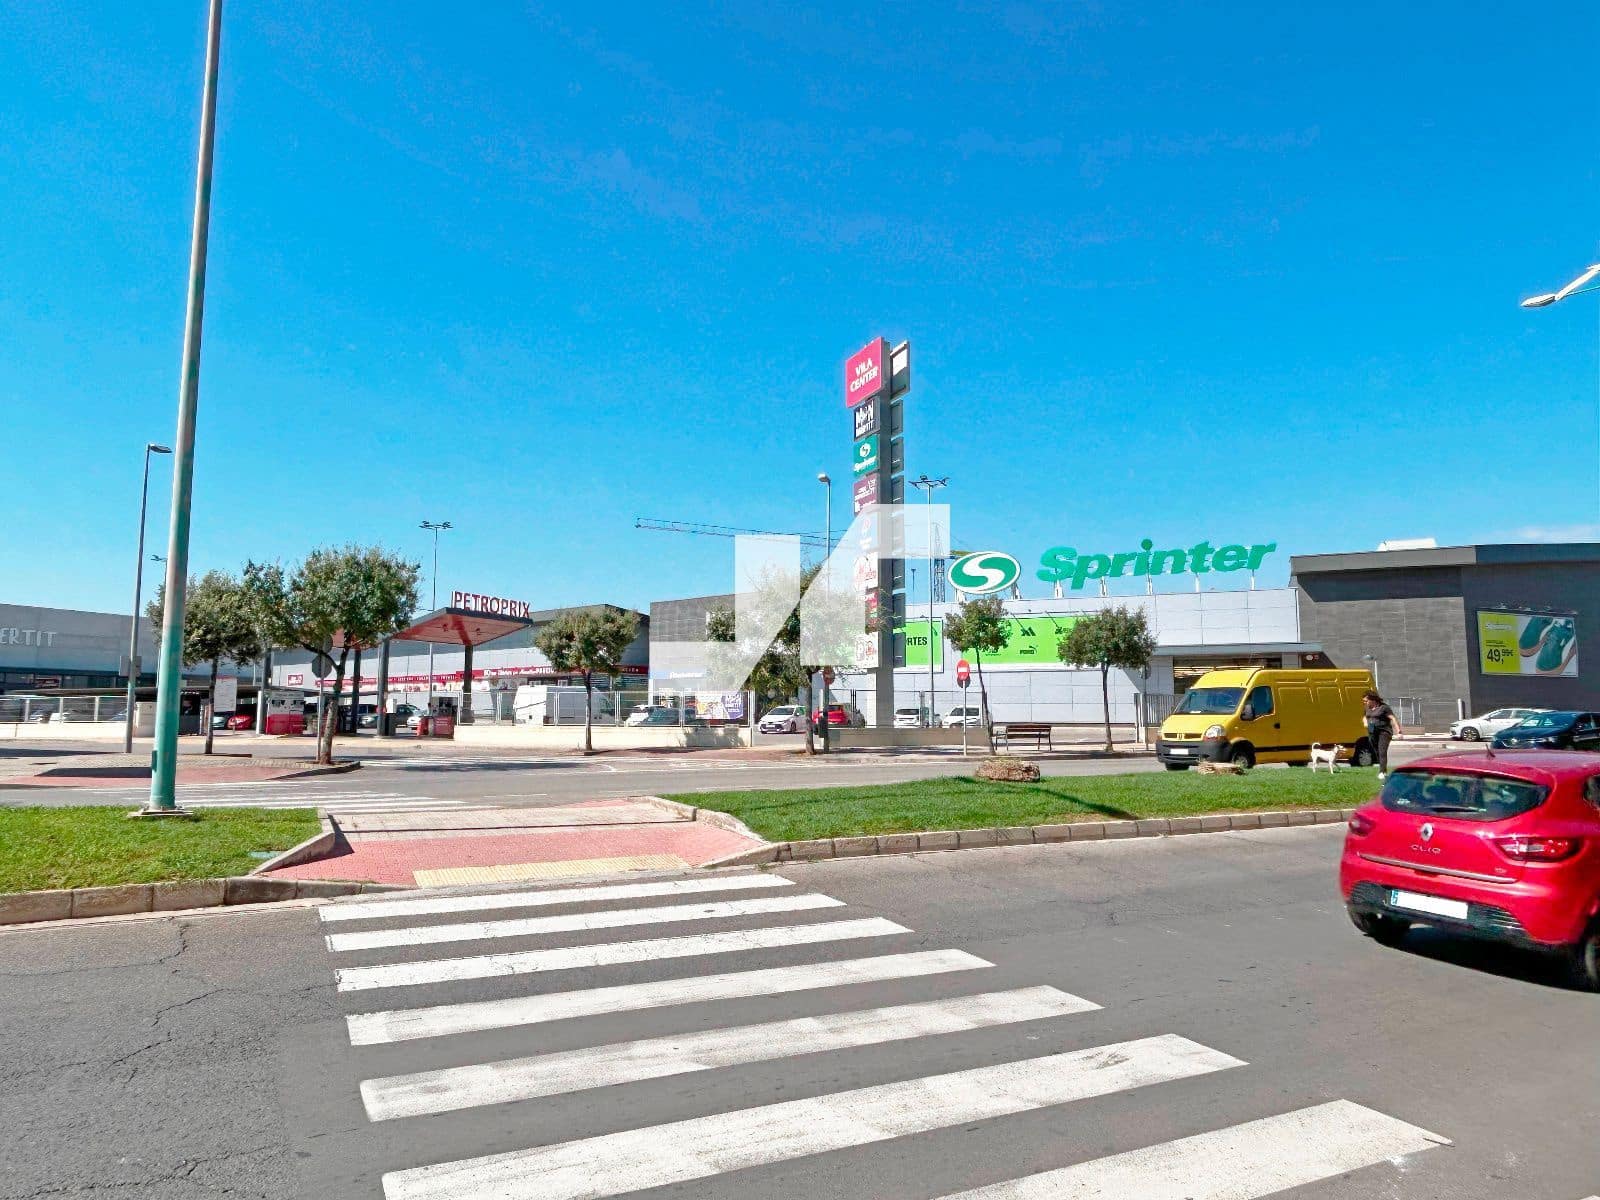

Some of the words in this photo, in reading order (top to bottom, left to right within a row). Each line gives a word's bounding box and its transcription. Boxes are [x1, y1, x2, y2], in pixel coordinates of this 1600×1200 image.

[855, 357, 873, 375] VILA
[850, 365, 879, 393] CENTER
[1036, 539, 1277, 590] Sprinter
[451, 591, 530, 618] PETROPRIX
[906, 636, 928, 646] RTES
[1410, 844, 1441, 855] CLIO
